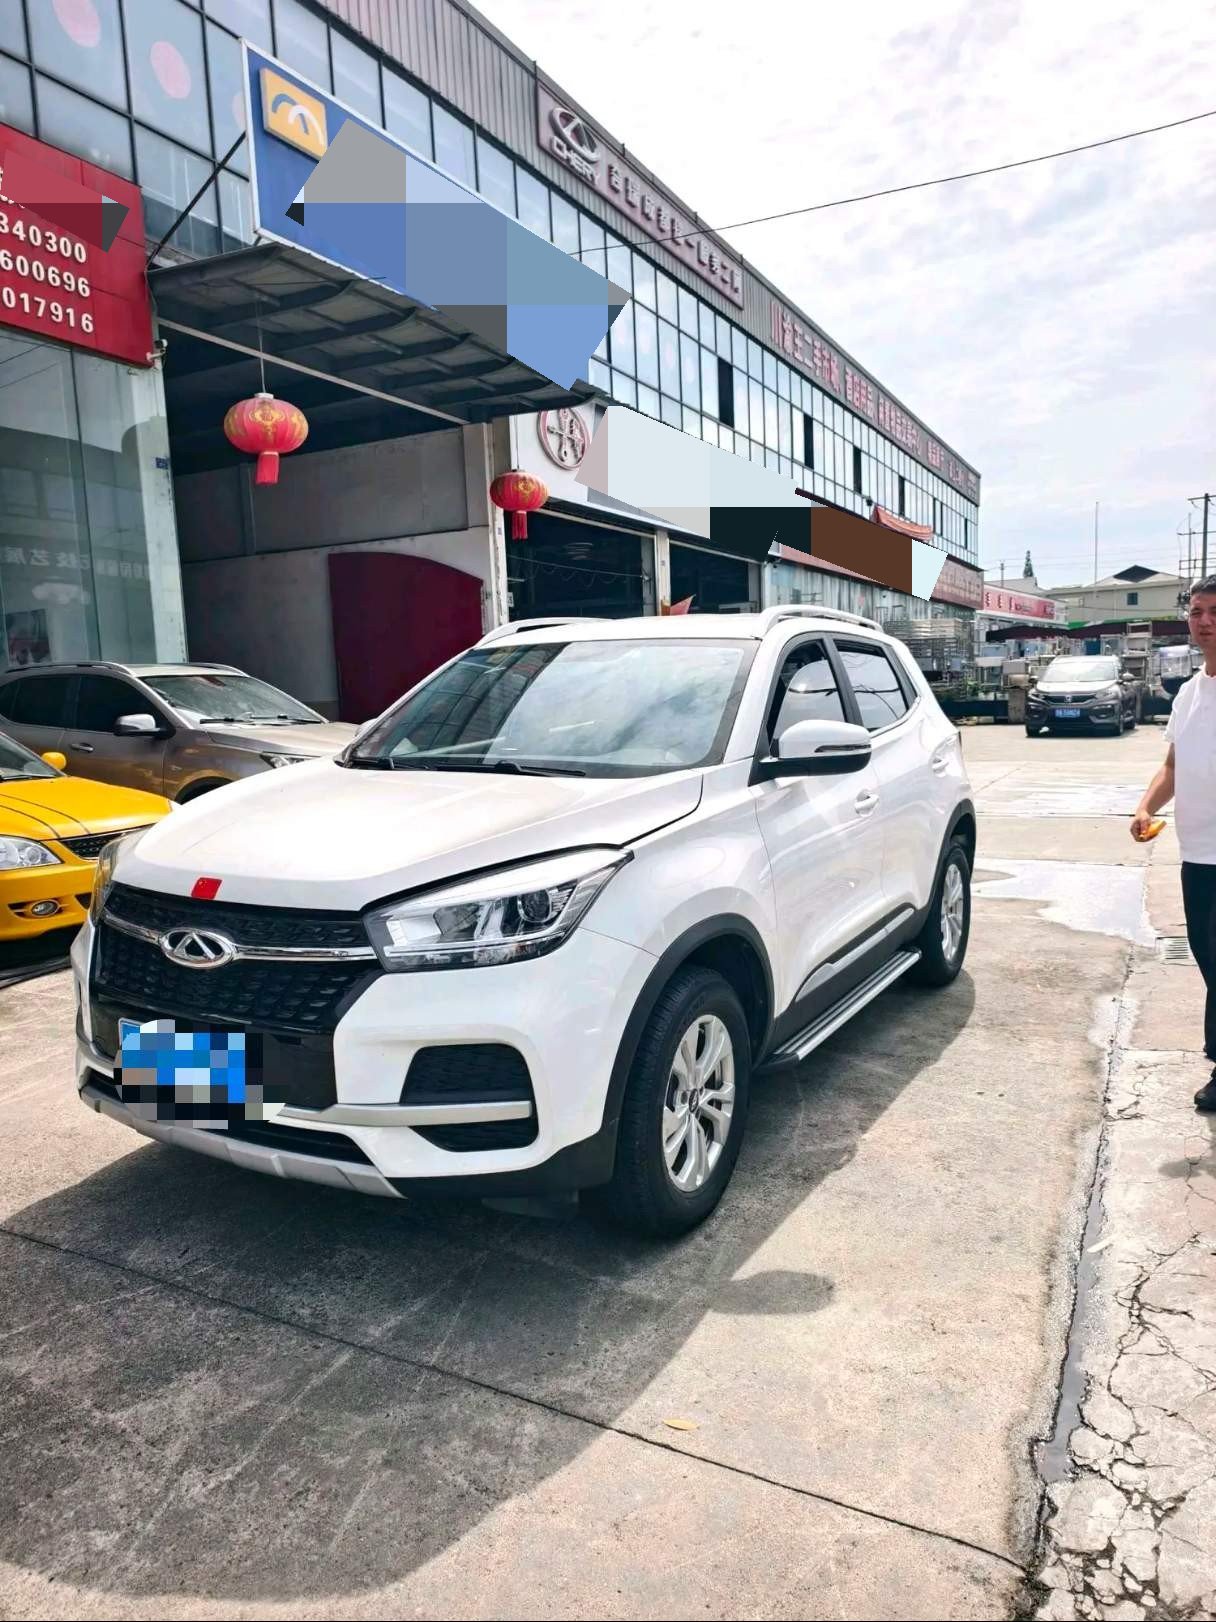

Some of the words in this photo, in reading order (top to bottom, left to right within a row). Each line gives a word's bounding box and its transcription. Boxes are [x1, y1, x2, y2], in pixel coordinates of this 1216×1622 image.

[552, 135, 600, 186] CHERY
[0, 250, 90, 297] 600696
[3, 287, 93, 333] 017916
